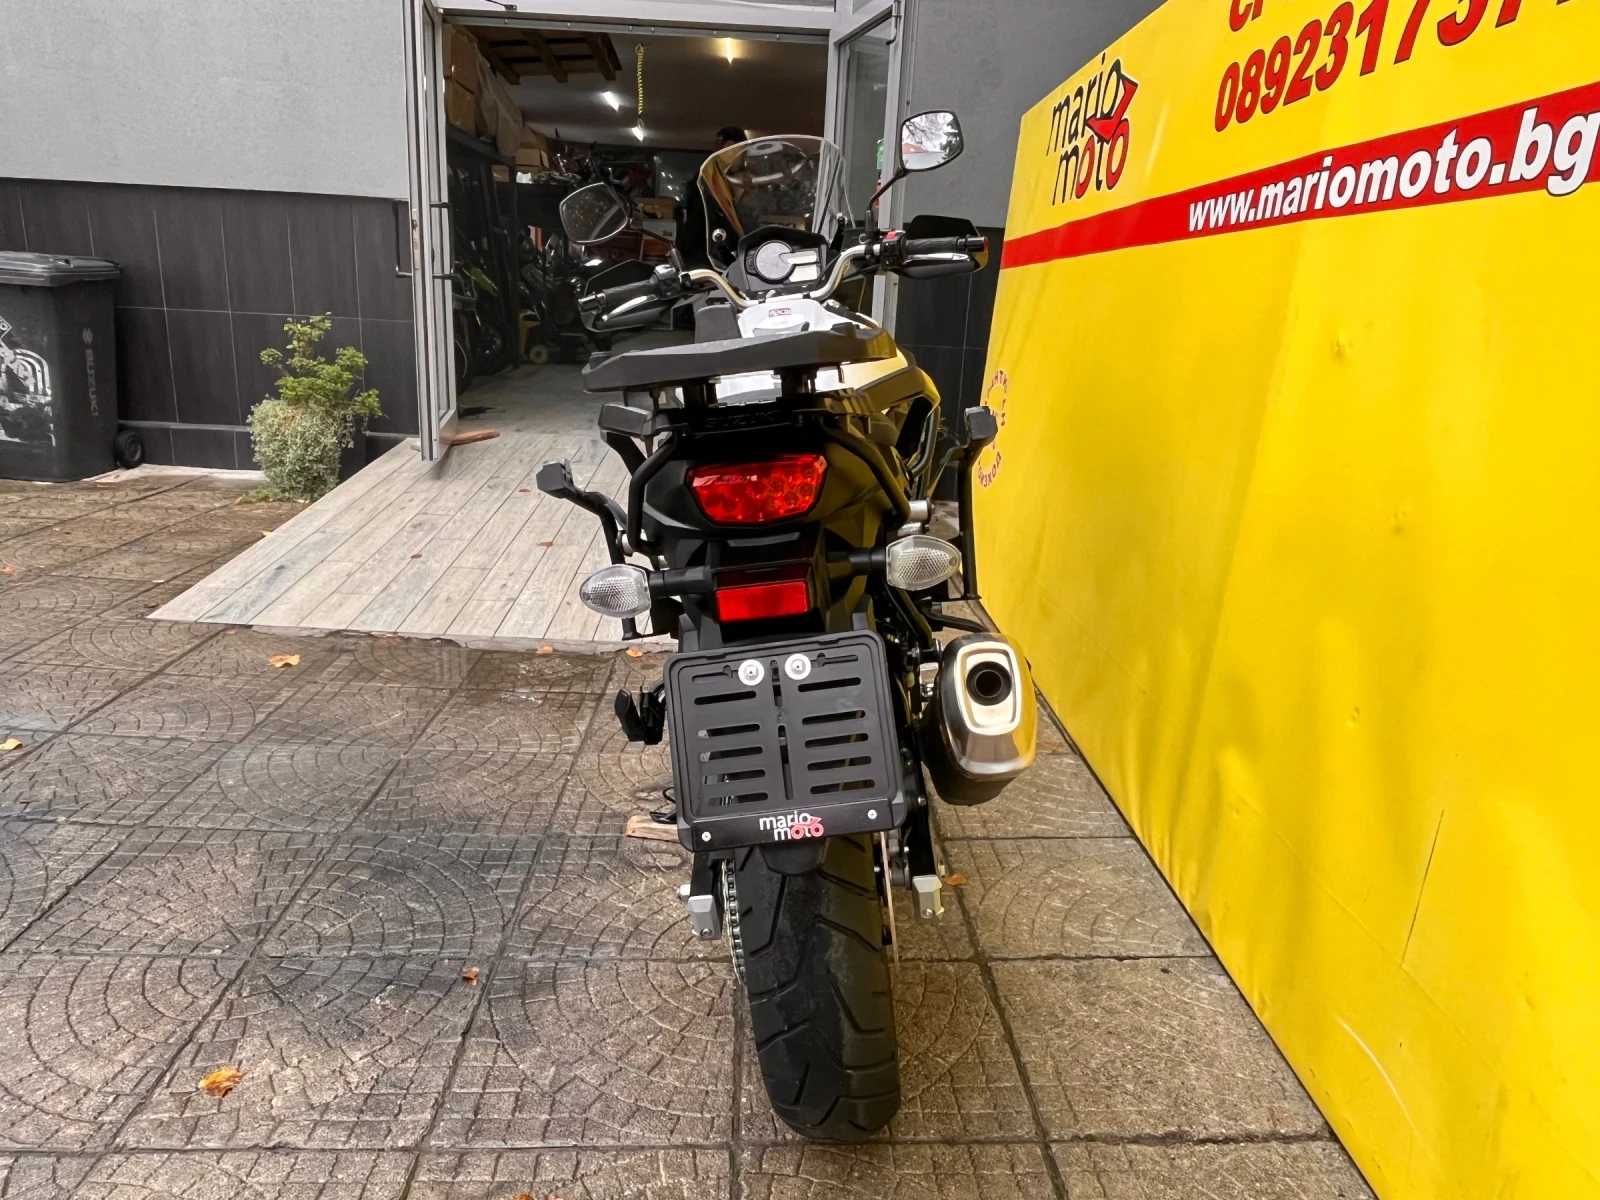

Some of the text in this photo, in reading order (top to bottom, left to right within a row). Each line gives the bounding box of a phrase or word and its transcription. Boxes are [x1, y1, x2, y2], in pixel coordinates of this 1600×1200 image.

[1046, 52, 1122, 157] mario
[1052, 118, 1130, 206] moto
[1188, 107, 1600, 232] www.mariomoto.bg
[759, 810, 811, 830] mario
[773, 823, 824, 841] moto
